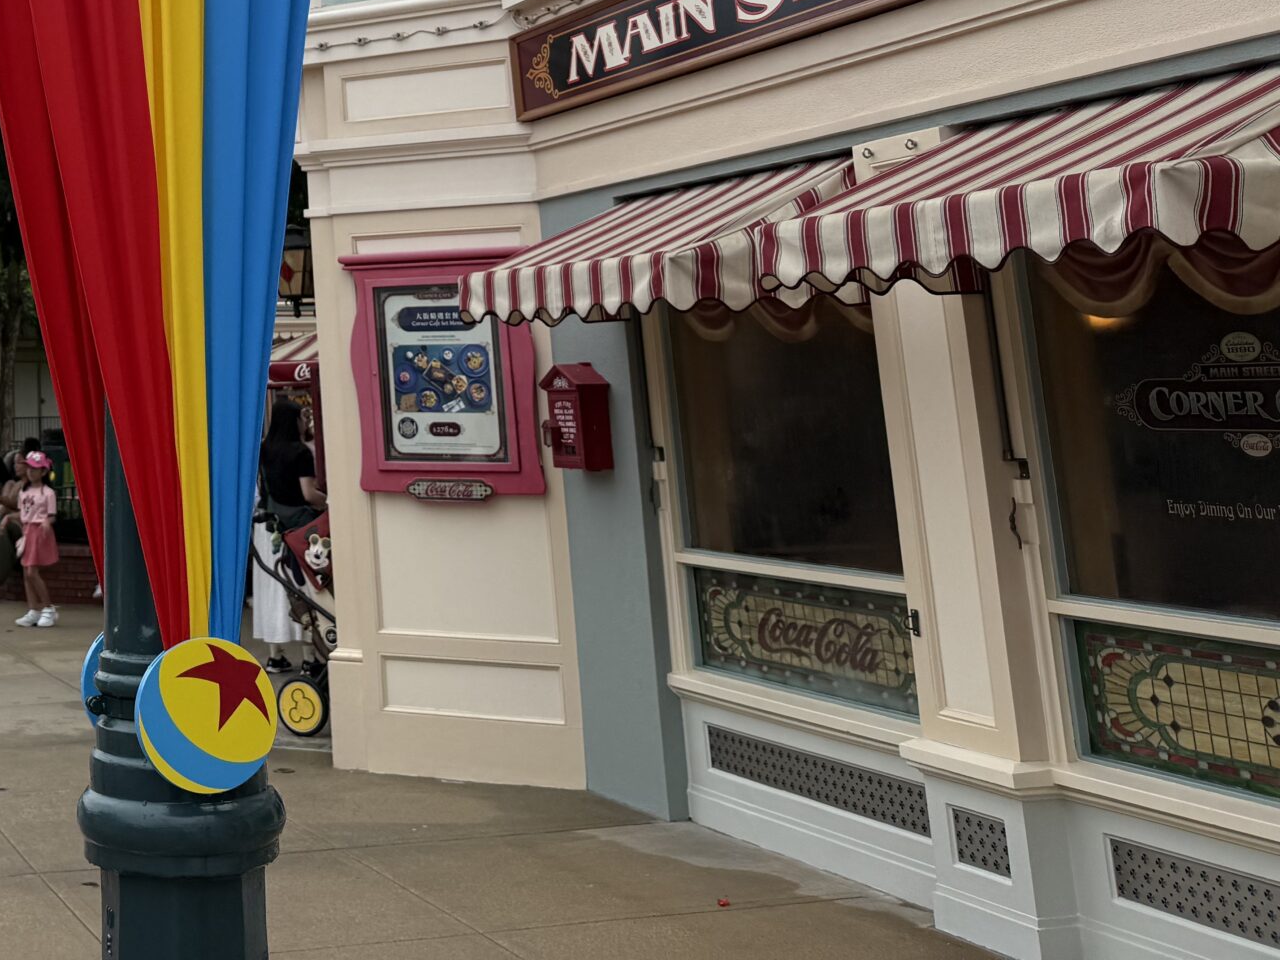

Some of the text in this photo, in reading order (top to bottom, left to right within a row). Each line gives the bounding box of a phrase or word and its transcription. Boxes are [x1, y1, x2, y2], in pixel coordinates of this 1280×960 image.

[1209, 367, 1238, 378] MAIN
[1149, 387, 1280, 423] CORNER
[1166, 499, 1276, 521] Enjoy Dining On Our
